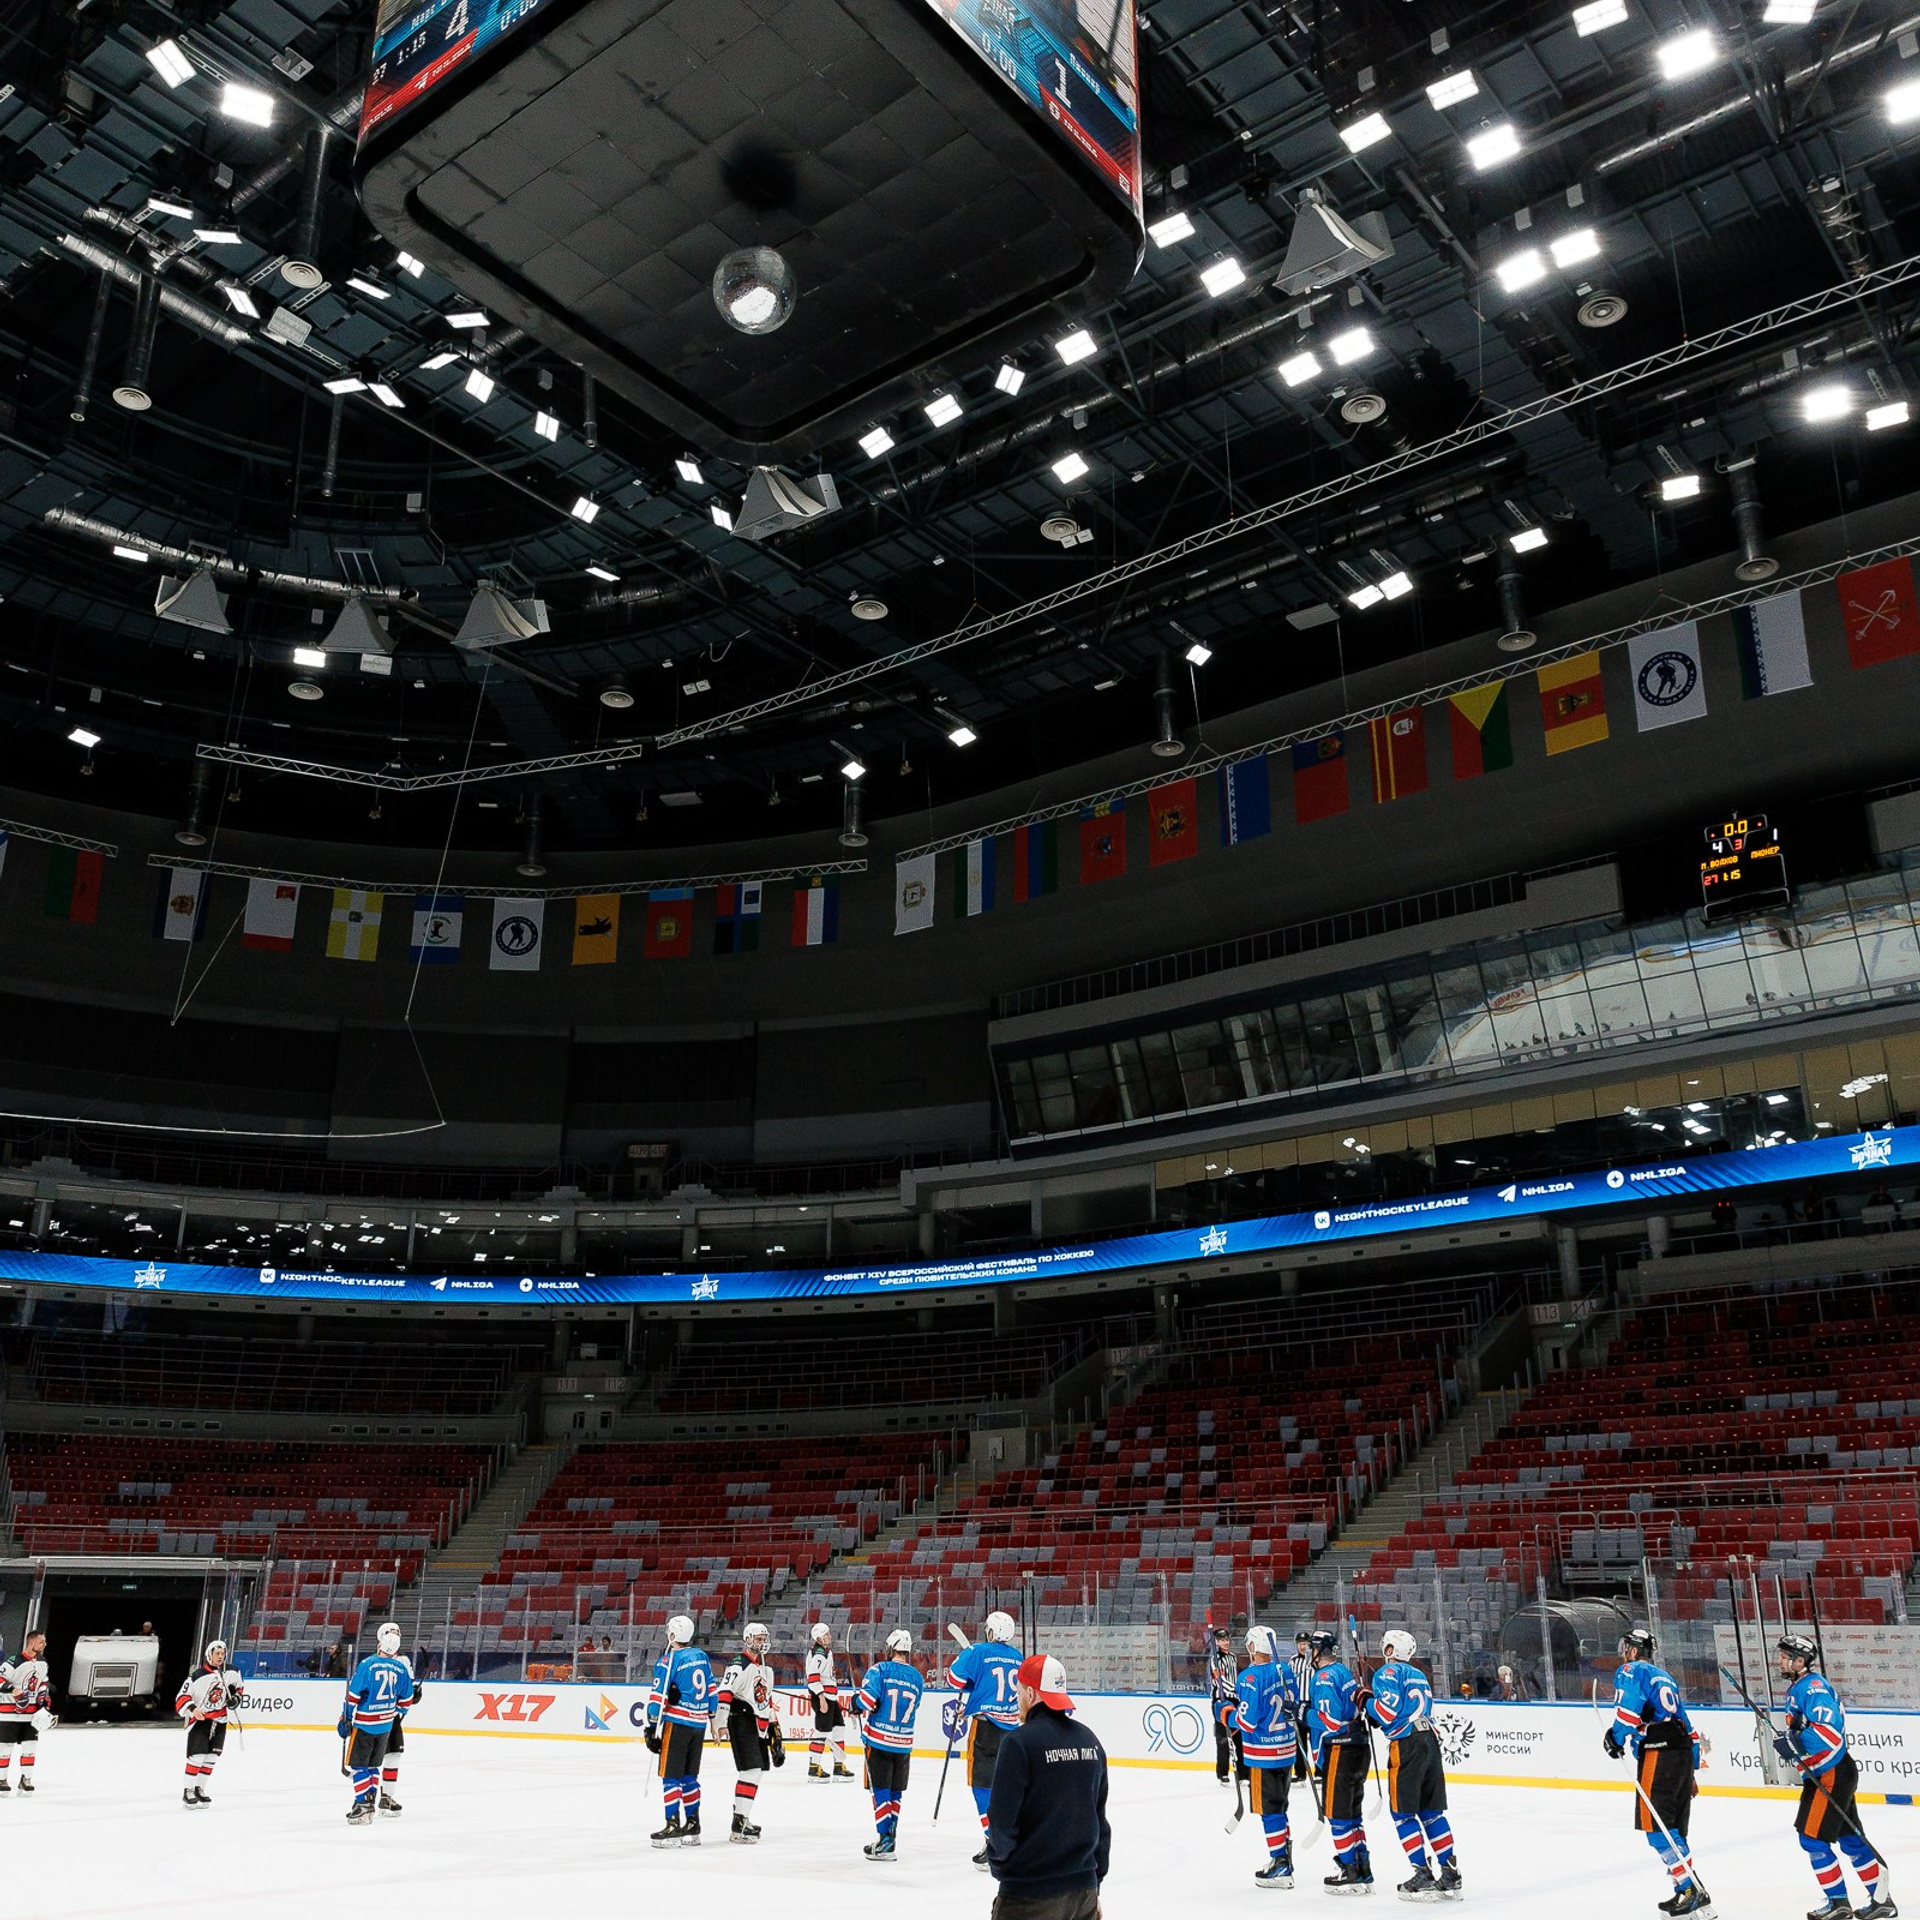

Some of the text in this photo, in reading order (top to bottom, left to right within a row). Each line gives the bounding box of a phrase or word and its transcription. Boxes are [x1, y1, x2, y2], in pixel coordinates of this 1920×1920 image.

[445, 0, 469, 40] 4
[396, 31, 427, 66] 1:15
[1054, 57, 1072, 109] 1
[1724, 819, 1748, 837] 0.0
[1773, 828, 1779, 841] 1
[1712, 838, 1743, 854] 4 3
[1703, 873, 1719, 886] 27
[1629, 1166, 1687, 1182] NHLIGA
[1521, 1181, 1576, 1197] NHLIGA
[1334, 1196, 1470, 1223] NIGHTHOCKEYLEAGUE
[823, 1249, 1095, 1282] ФОНБЕТ XIV ВСЕРОССИЙСКИЙ ФЕСТИВАЛЬ ПО ХОККЕЮ
[280, 1273, 406, 1287] NIGHTHOCKEYLEAGUE
[879, 1264, 1038, 1286] СРЕДИ ЛЮБИТЕЛЬСКИХ КОМАНД
[451, 1280, 495, 1289] NHLIGA
[537, 1281, 580, 1289] NHLIGA
[1536, 1305, 1558, 1319] 113
[374, 1669, 398, 1701] 20
[692, 1668, 707, 1701] 9
[991, 1666, 1019, 1703] 19
[240, 1694, 294, 1713] Видео
[473, 1693, 557, 1722] X17
[887, 1688, 917, 1724] 17
[1381, 1690, 1400, 1708] 27
[1485, 1731, 1544, 1742] МИНСПОРТ
[1044, 1747, 1099, 1764] НОЧНАЯ ЛИГА
[1486, 1744, 1532, 1755] РОССИИ
